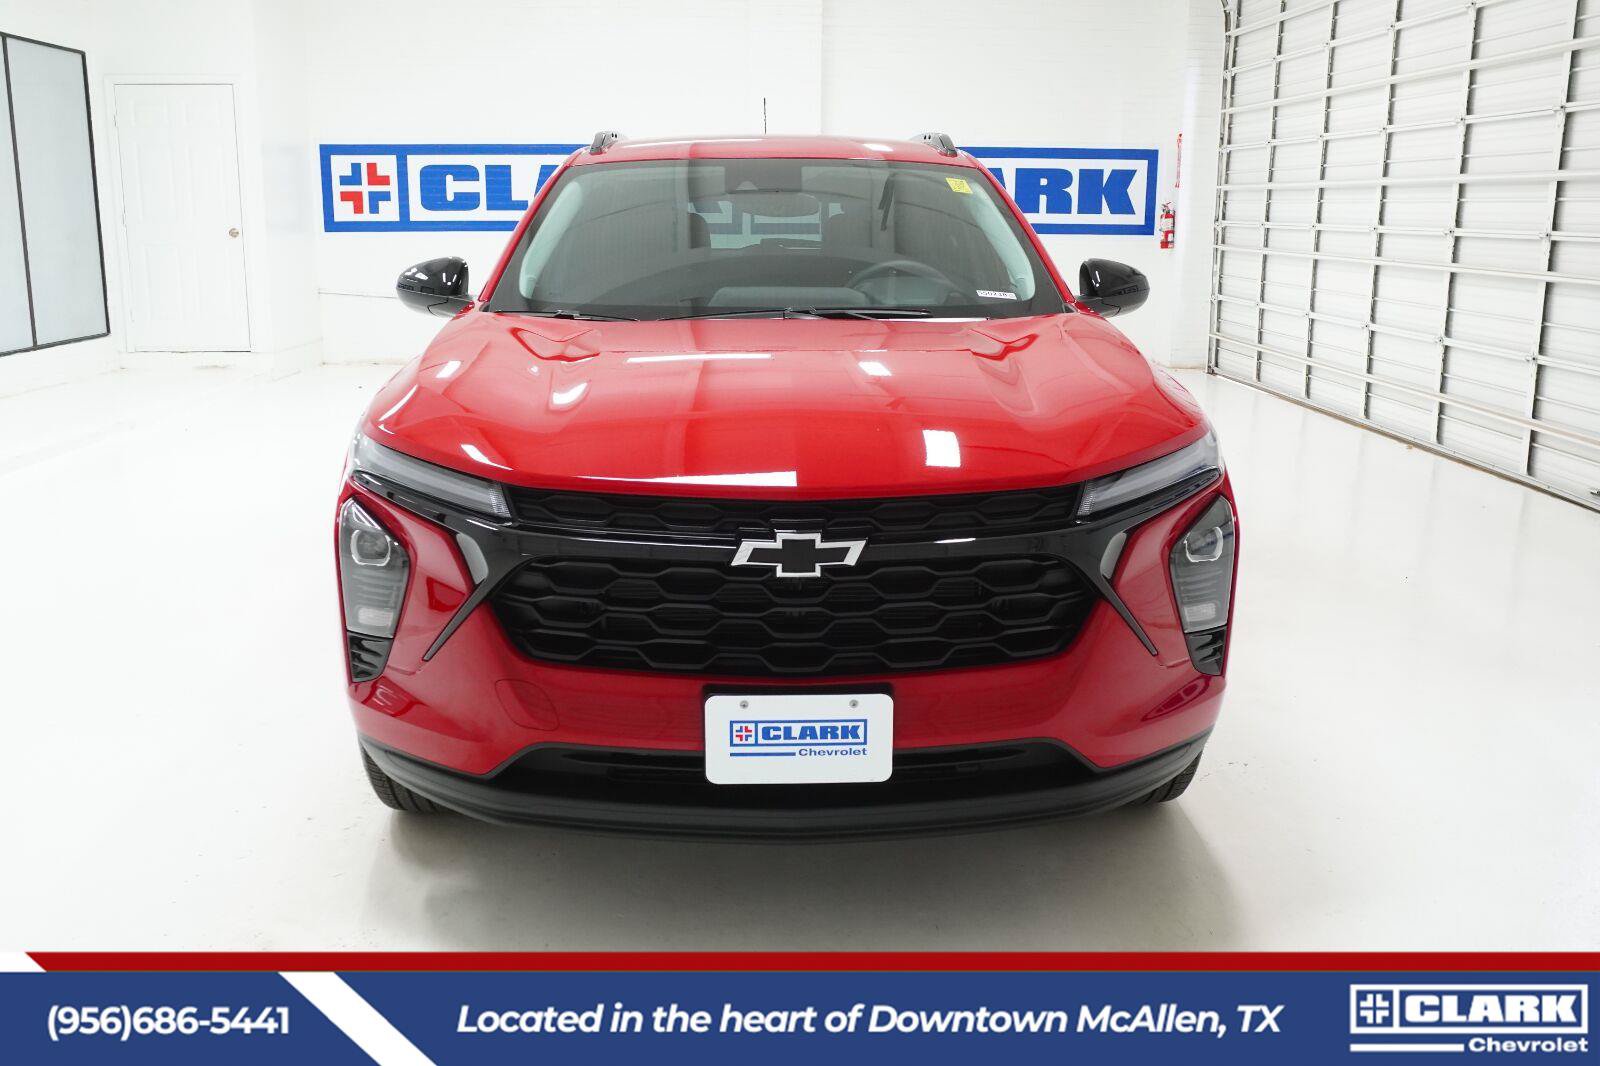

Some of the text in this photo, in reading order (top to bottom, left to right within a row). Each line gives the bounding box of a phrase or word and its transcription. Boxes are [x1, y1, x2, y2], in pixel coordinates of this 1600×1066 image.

[987, 168, 1137, 215] RK
[761, 725, 861, 741] CLARK
[798, 748, 868, 757] Chevrolet
